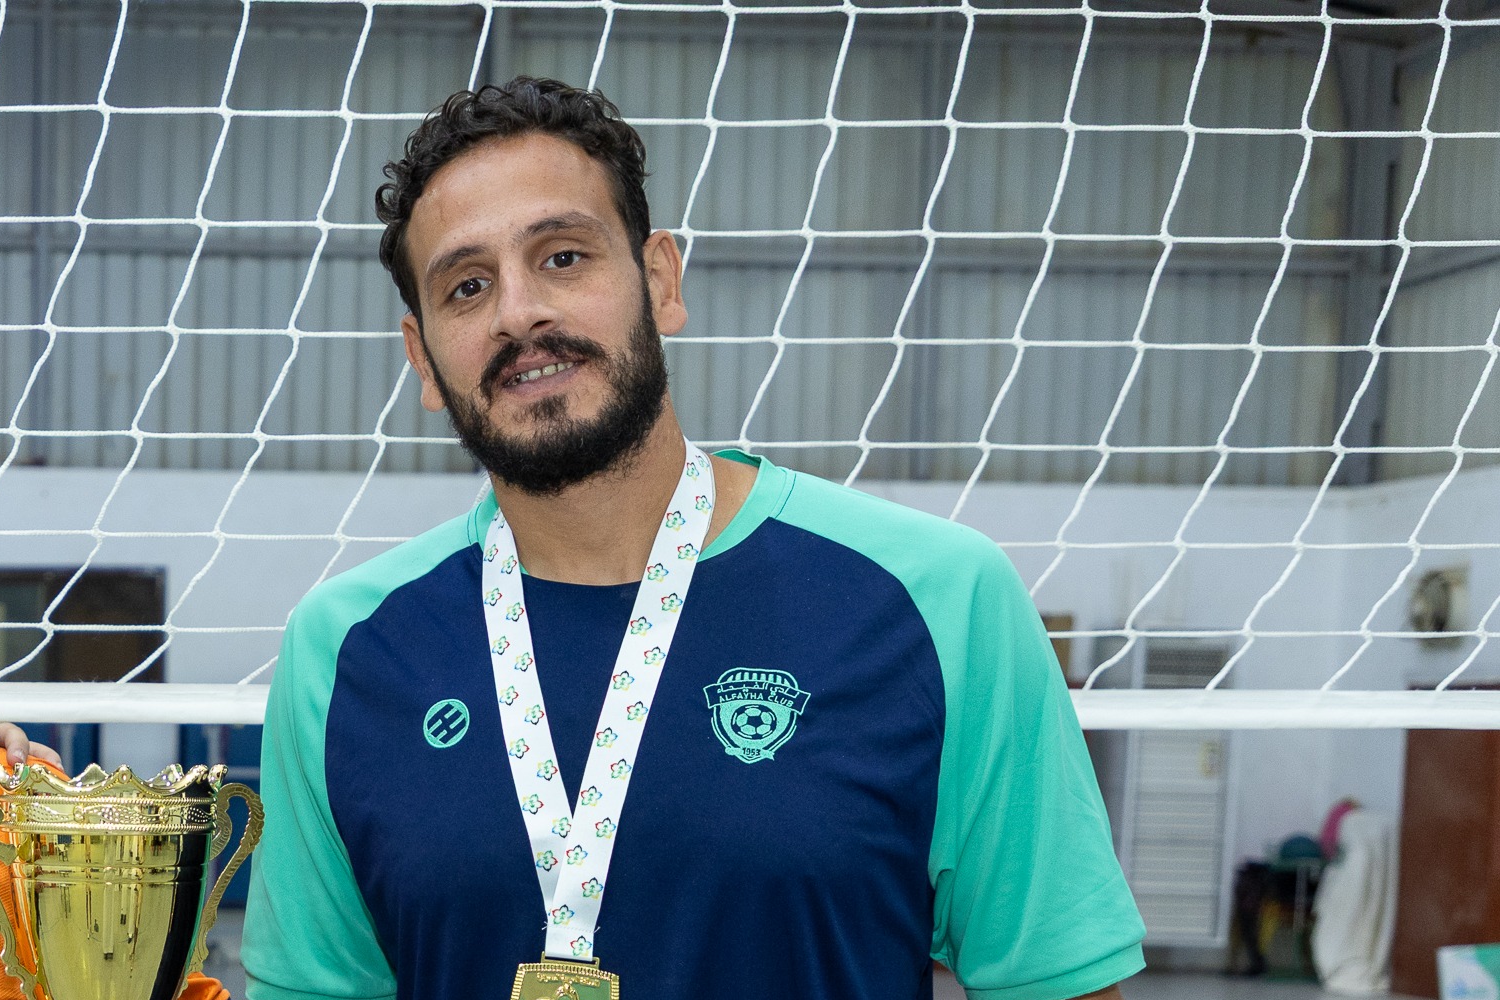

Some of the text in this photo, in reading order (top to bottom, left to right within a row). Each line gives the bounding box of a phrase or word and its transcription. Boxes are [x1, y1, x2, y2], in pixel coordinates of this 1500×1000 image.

[717, 682, 800, 699] نادي الفيحاء
[719, 692, 794, 708] ALFAYHA CLUB
[742, 747, 761, 756] 1953
